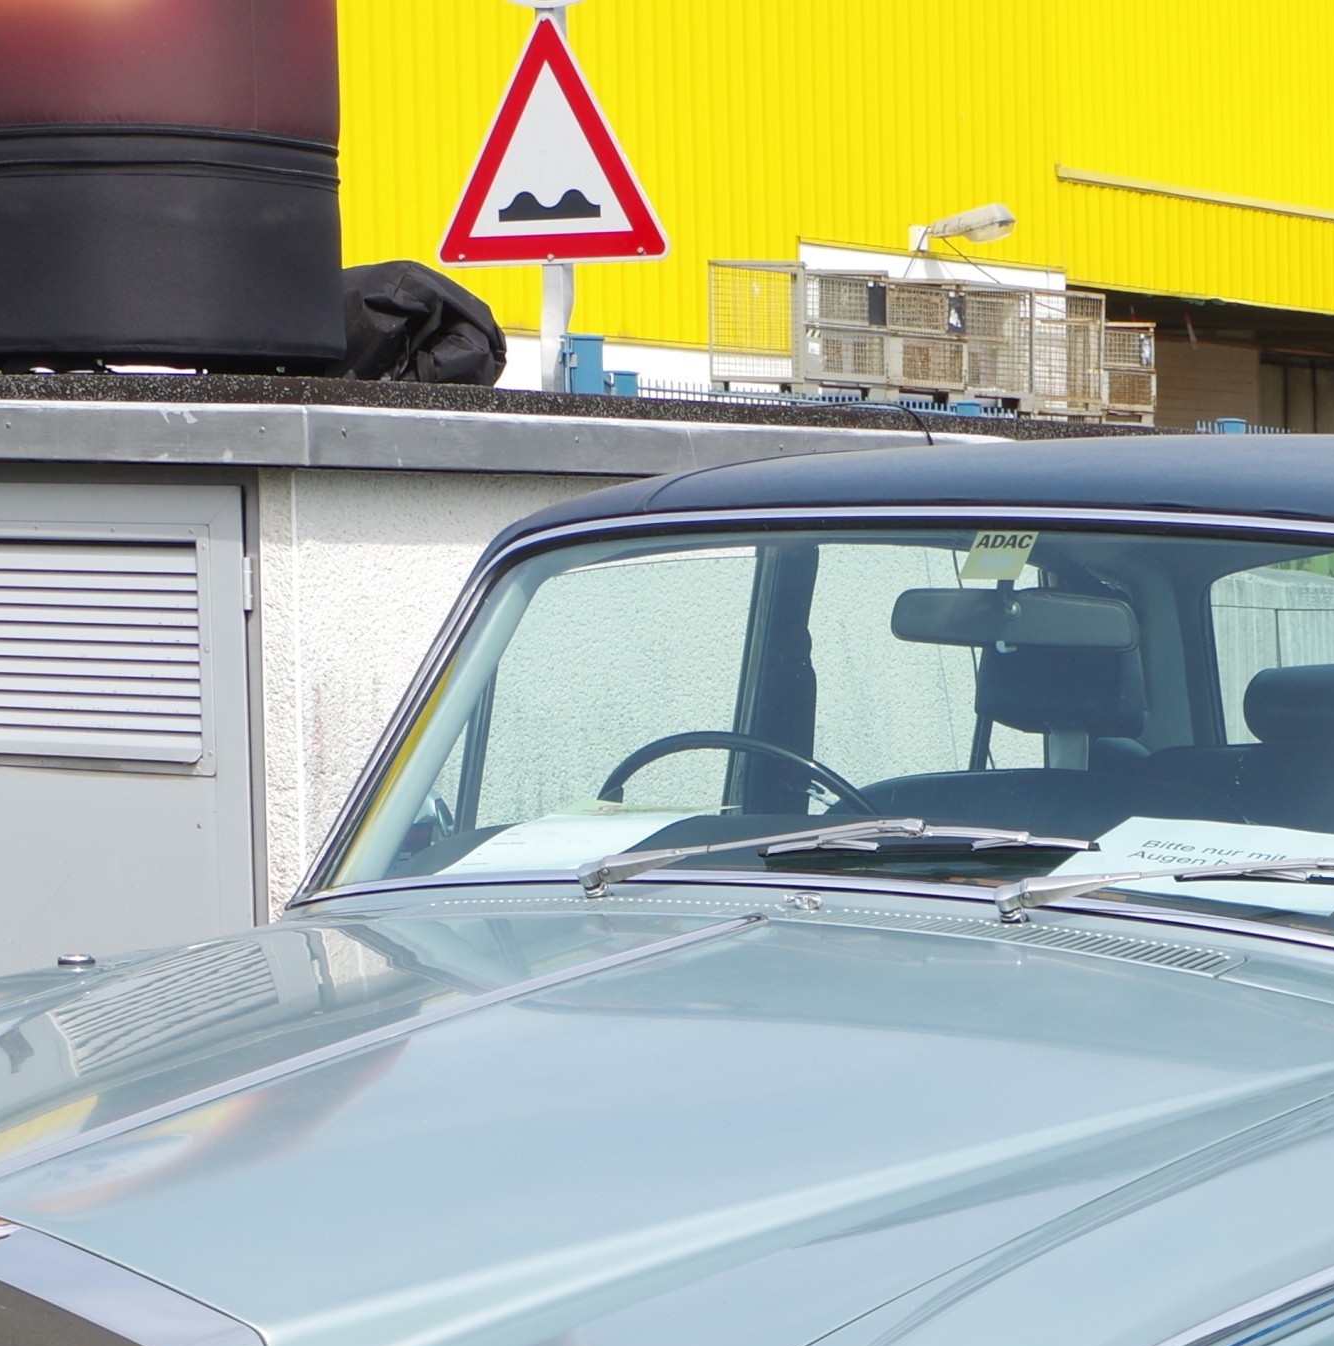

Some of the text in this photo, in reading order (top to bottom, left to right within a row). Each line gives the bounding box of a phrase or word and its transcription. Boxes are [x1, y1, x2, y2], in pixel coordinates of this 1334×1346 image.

[975, 534, 1034, 550] ADAC
[1141, 839, 1196, 853] Bitte
[1201, 847, 1245, 857] nur
[1127, 849, 1207, 867] Augen
